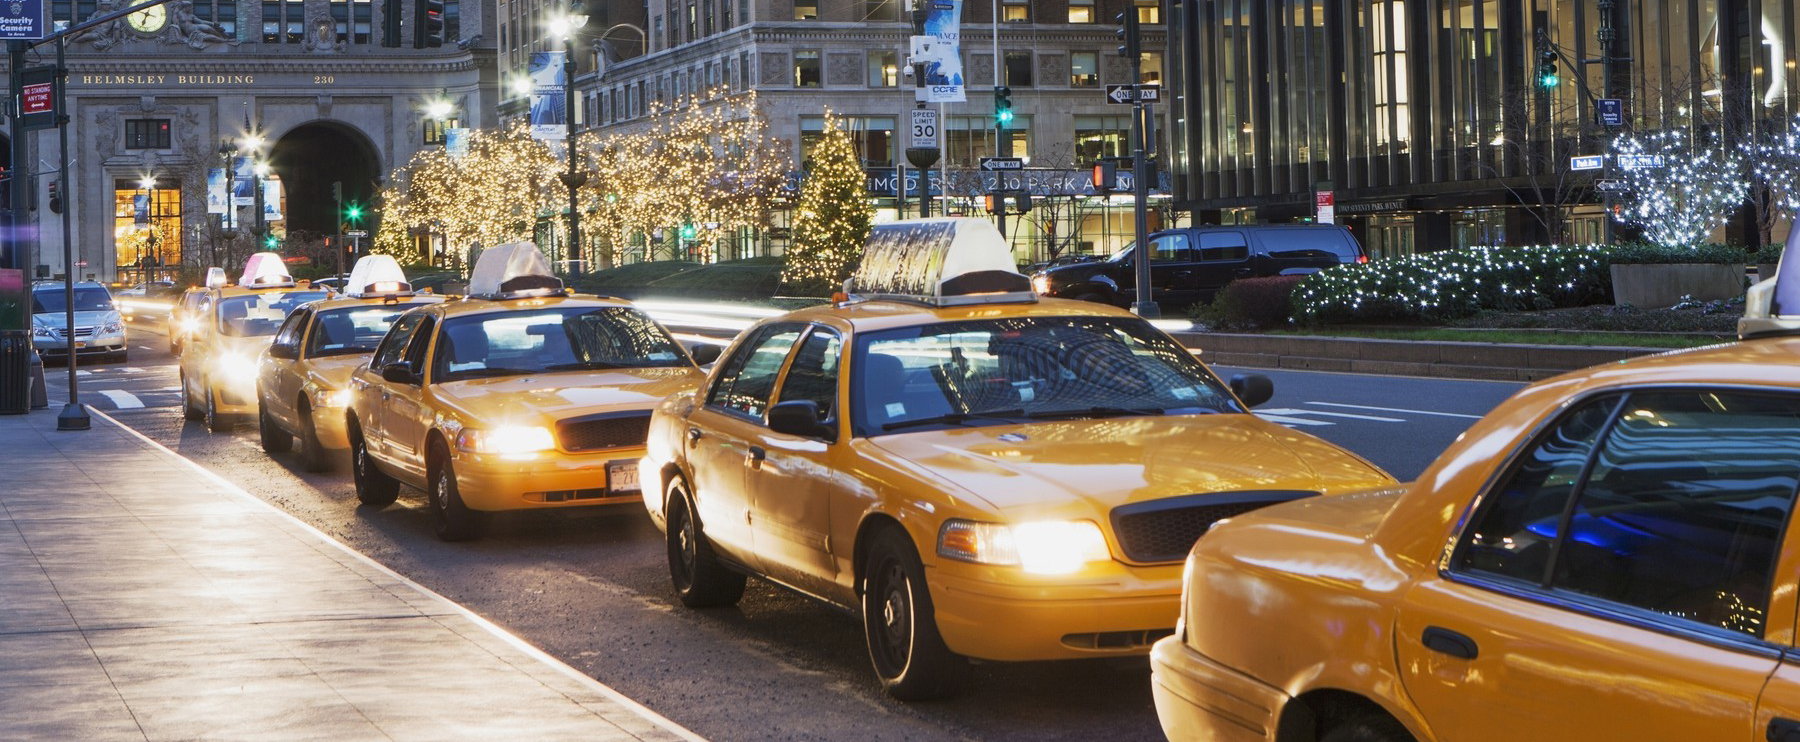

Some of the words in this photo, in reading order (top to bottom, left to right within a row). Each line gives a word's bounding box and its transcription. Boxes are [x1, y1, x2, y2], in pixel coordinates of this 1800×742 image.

[0, 16, 33, 25] Security
[83, 75, 165, 84] HELMSLEY
[178, 75, 254, 84] BUILDING
[314, 75, 334, 84] 230
[31, 86, 51, 94] STANDING
[27, 94, 48, 102] ANYTIME
[1116, 91, 1133, 99] ONE
[914, 125, 935, 137] 30
[1029, 177, 1076, 190] PARK
